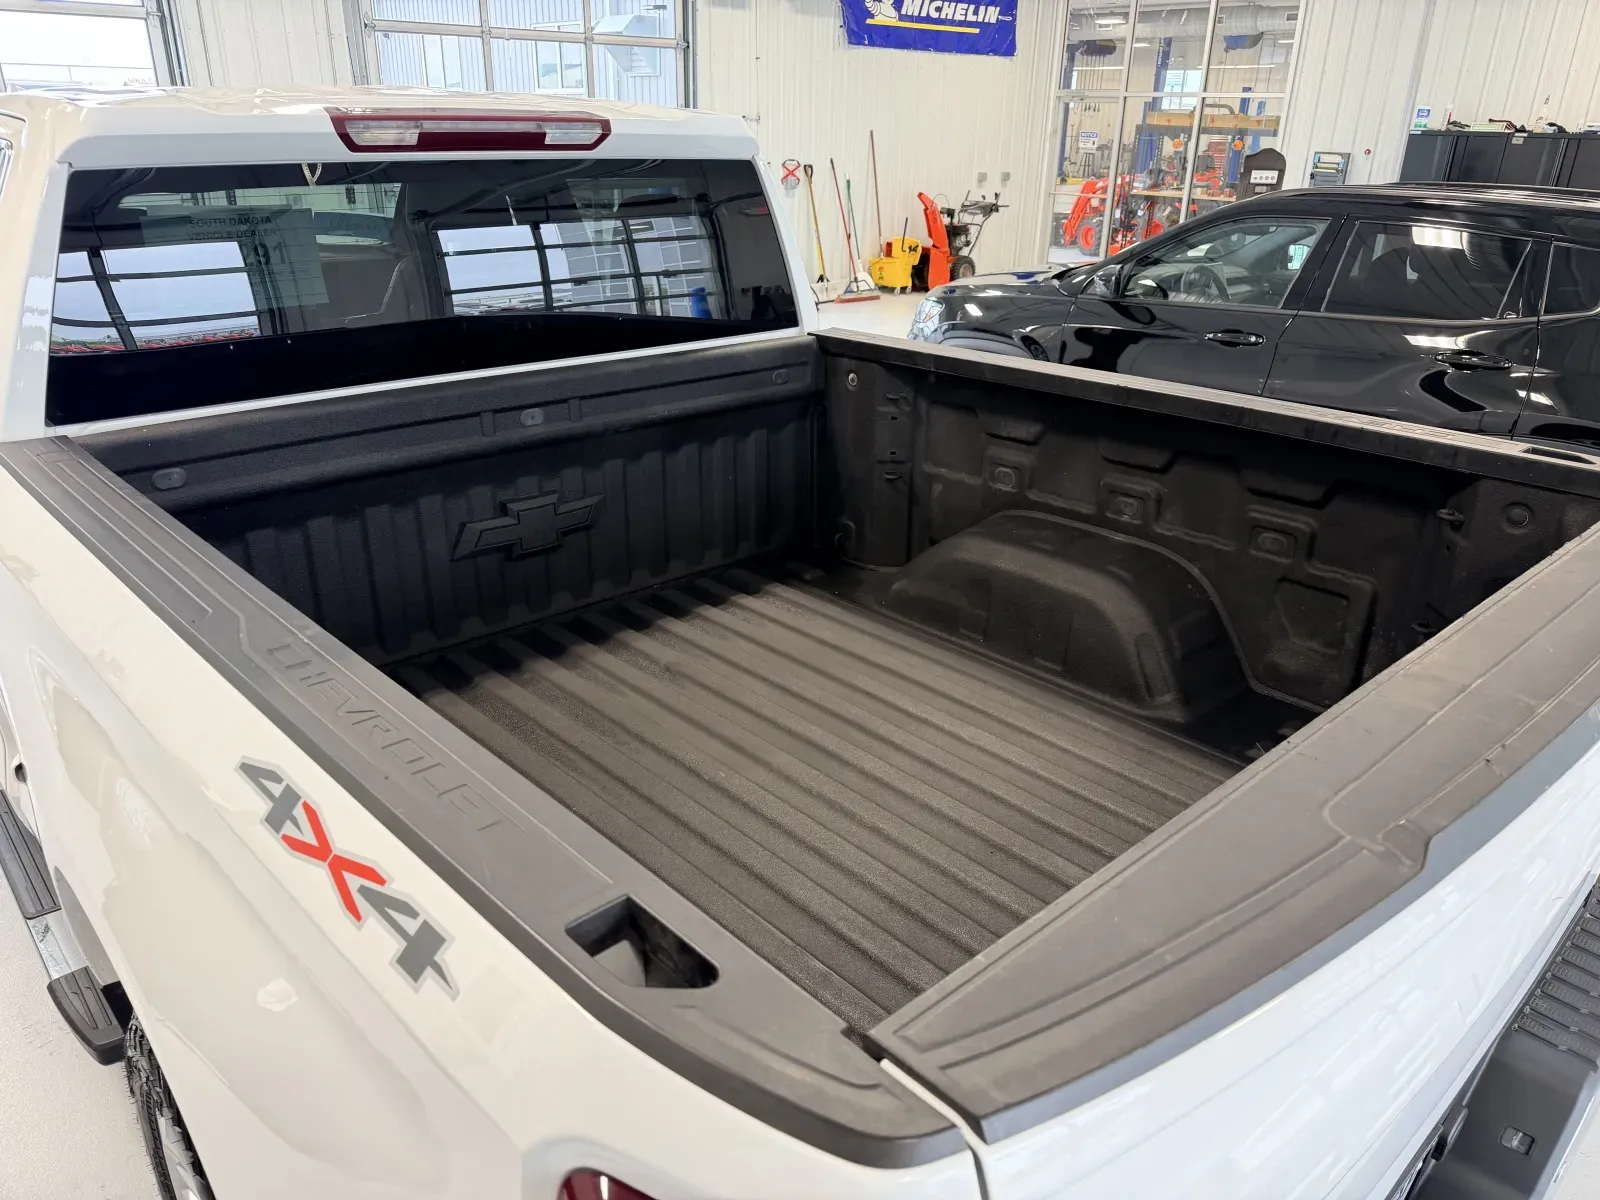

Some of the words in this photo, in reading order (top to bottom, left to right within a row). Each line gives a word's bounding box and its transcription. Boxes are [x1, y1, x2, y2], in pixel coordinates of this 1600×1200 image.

[901, 0, 1000, 24] MICHELIN
[188, 218, 226, 229] SOUTH
[229, 215, 272, 226] DAKOTA
[236, 227, 278, 239] DEALER
[266, 643, 529, 833] CHEVROLET
